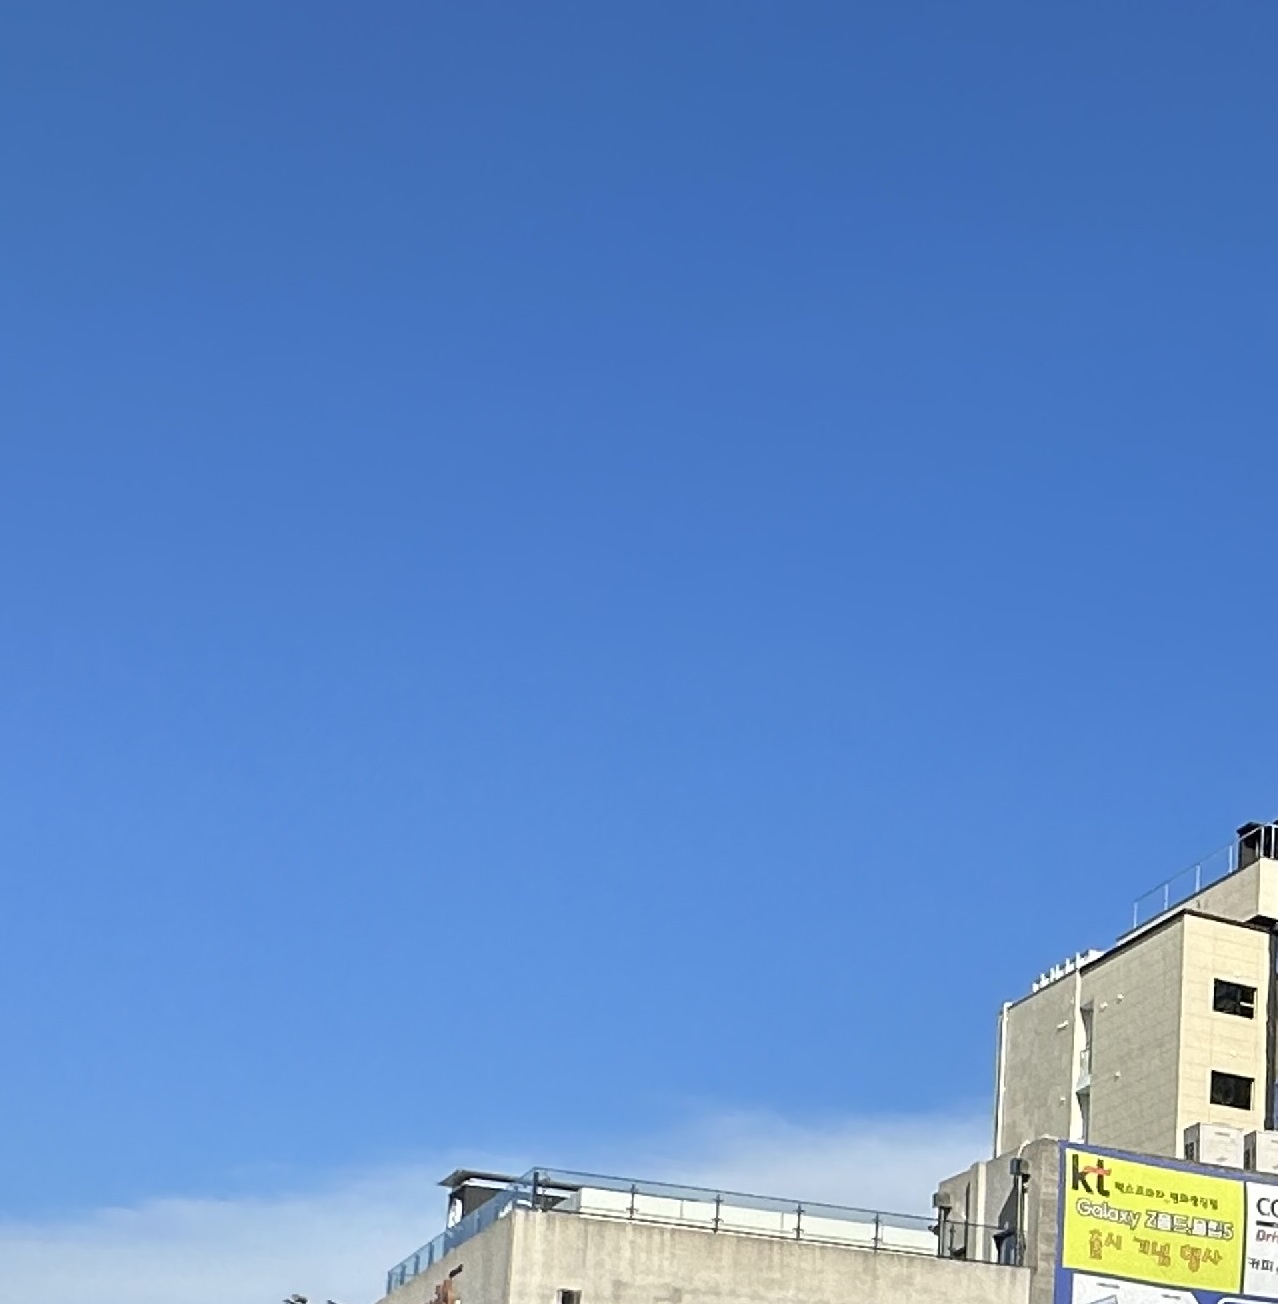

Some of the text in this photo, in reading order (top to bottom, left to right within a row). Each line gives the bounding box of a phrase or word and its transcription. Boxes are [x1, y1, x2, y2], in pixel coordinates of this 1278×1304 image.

[1072, 1153, 1112, 1198] kt
[1076, 1198, 1141, 1230] Galaxy
[1090, 1228, 1223, 1273] 출시 기념 행사
